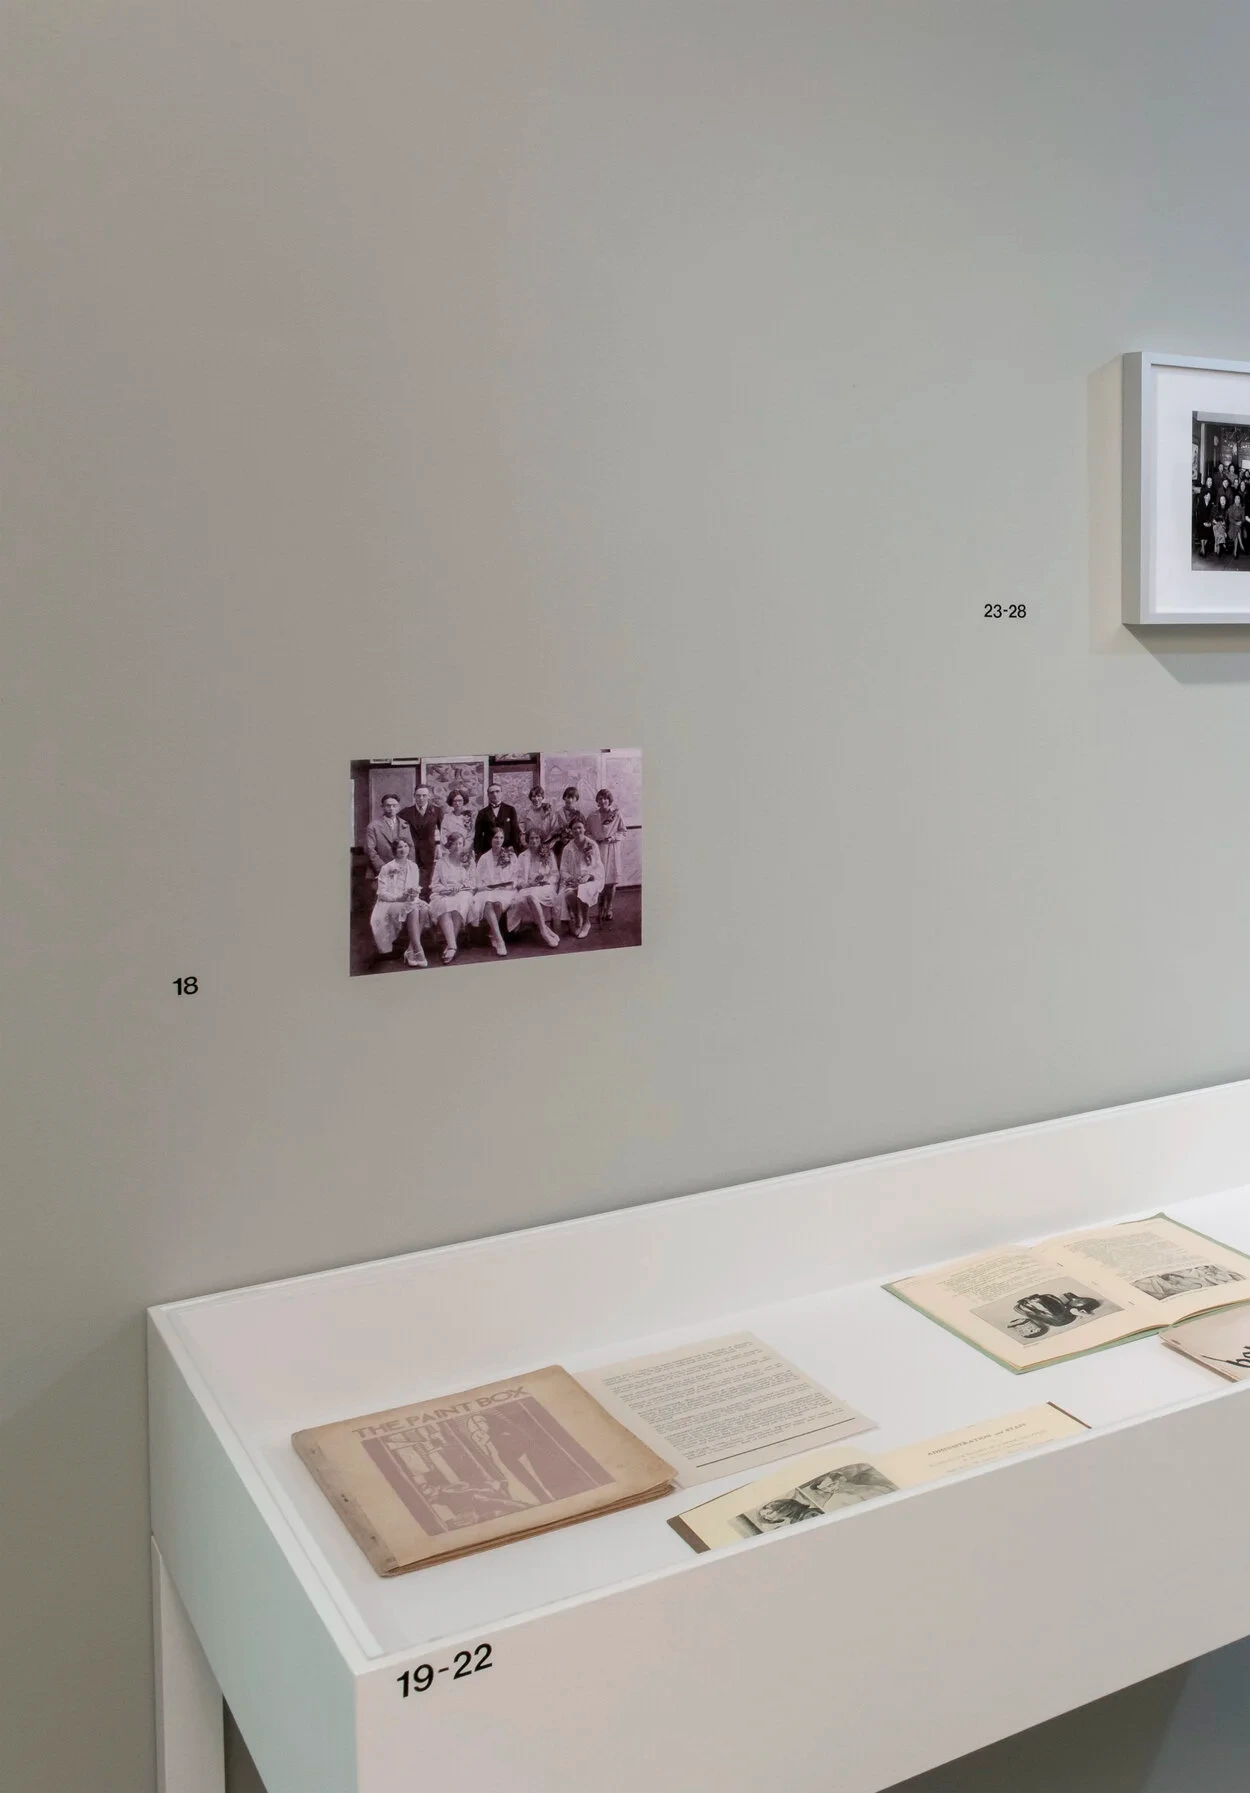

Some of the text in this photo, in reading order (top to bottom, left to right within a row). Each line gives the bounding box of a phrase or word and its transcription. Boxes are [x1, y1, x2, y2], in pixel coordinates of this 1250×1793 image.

[984, 603, 1027, 618] 23-28
[172, 976, 198, 995] 18
[352, 1385, 530, 1439] THE PAINT BOX
[397, 1643, 493, 1698] 19-22
